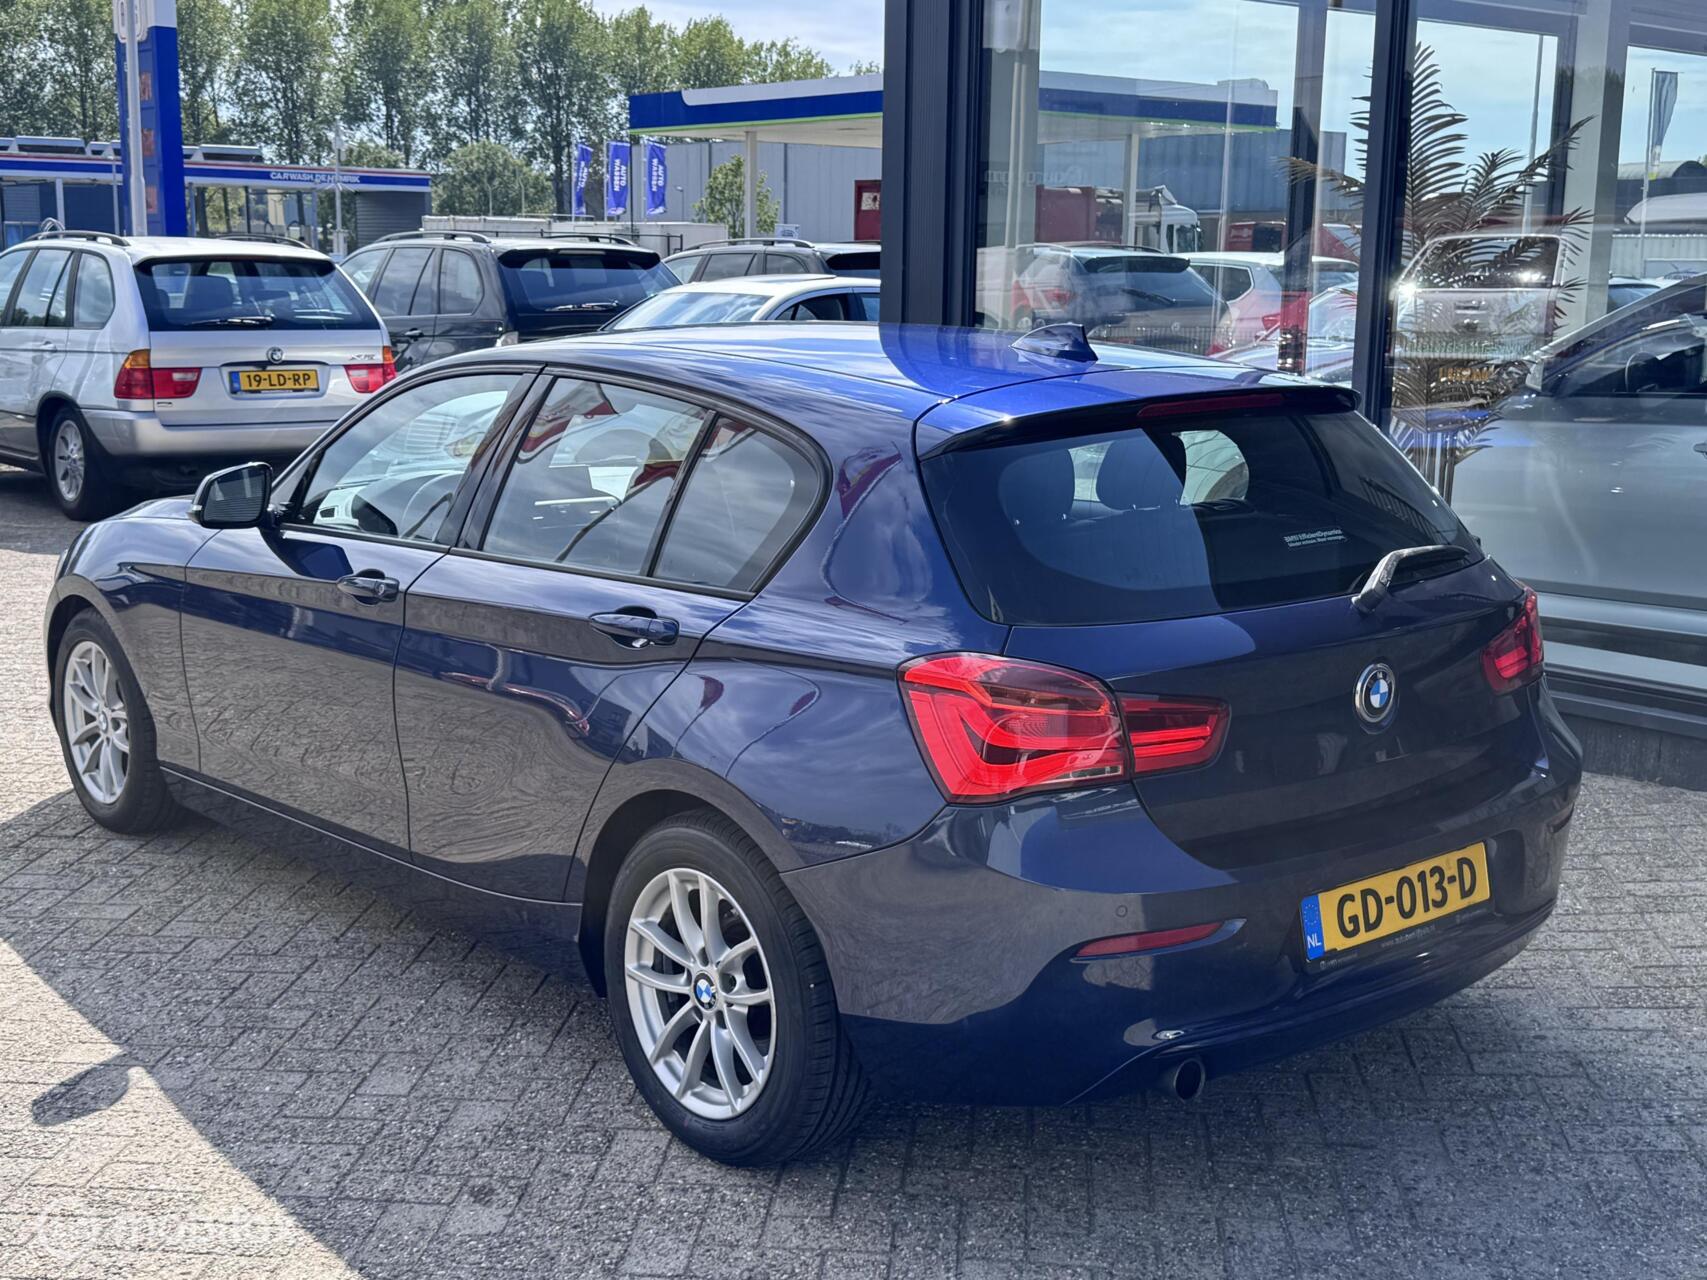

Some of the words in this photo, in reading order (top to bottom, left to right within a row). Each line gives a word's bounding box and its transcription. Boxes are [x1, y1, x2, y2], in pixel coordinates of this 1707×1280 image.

[270, 172, 313, 181] CARWASH
[246, 373, 311, 388] 19-LD-RP
[1337, 857, 1477, 938] GD-013-D
[1307, 933, 1322, 948] NL
